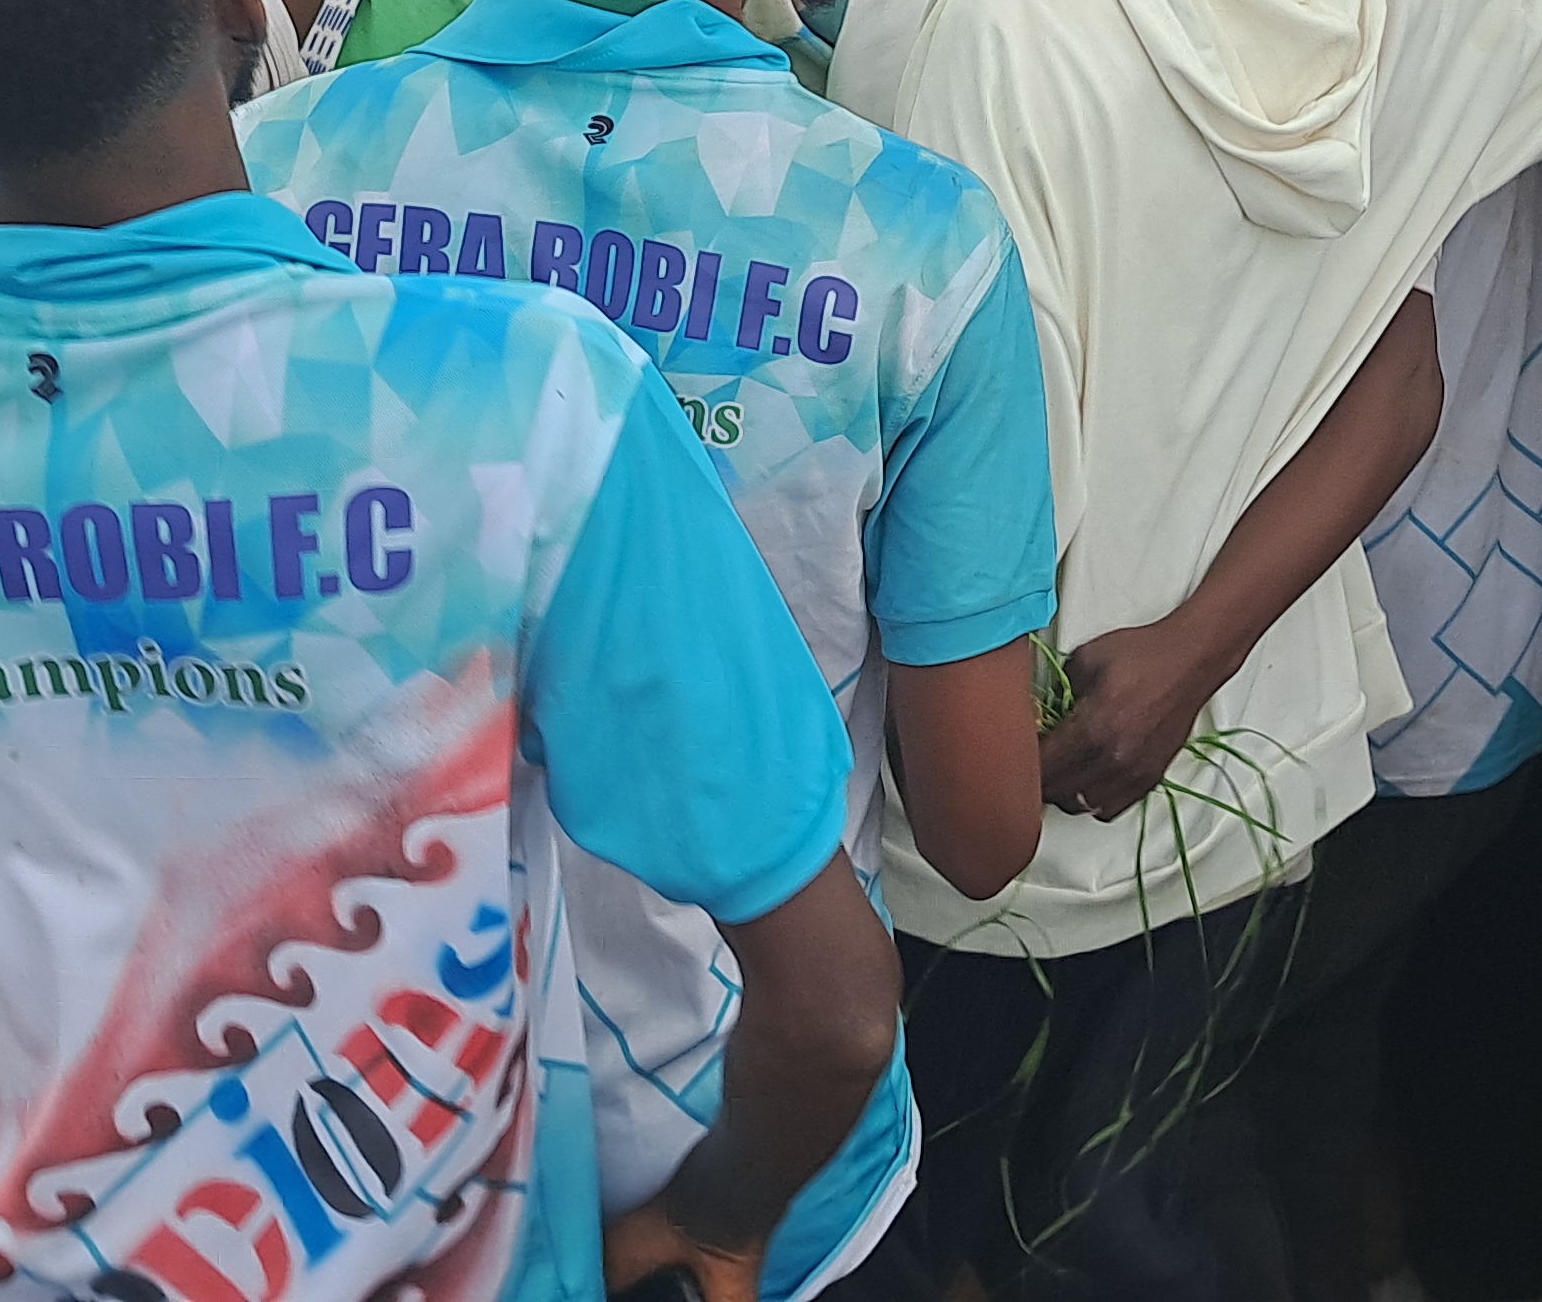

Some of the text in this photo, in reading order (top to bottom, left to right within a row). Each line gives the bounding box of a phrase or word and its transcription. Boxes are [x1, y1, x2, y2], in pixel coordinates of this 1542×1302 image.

[530, 218, 724, 344] ROBI
[736, 259, 860, 366] F.C
[269, 486, 415, 598] F.C
